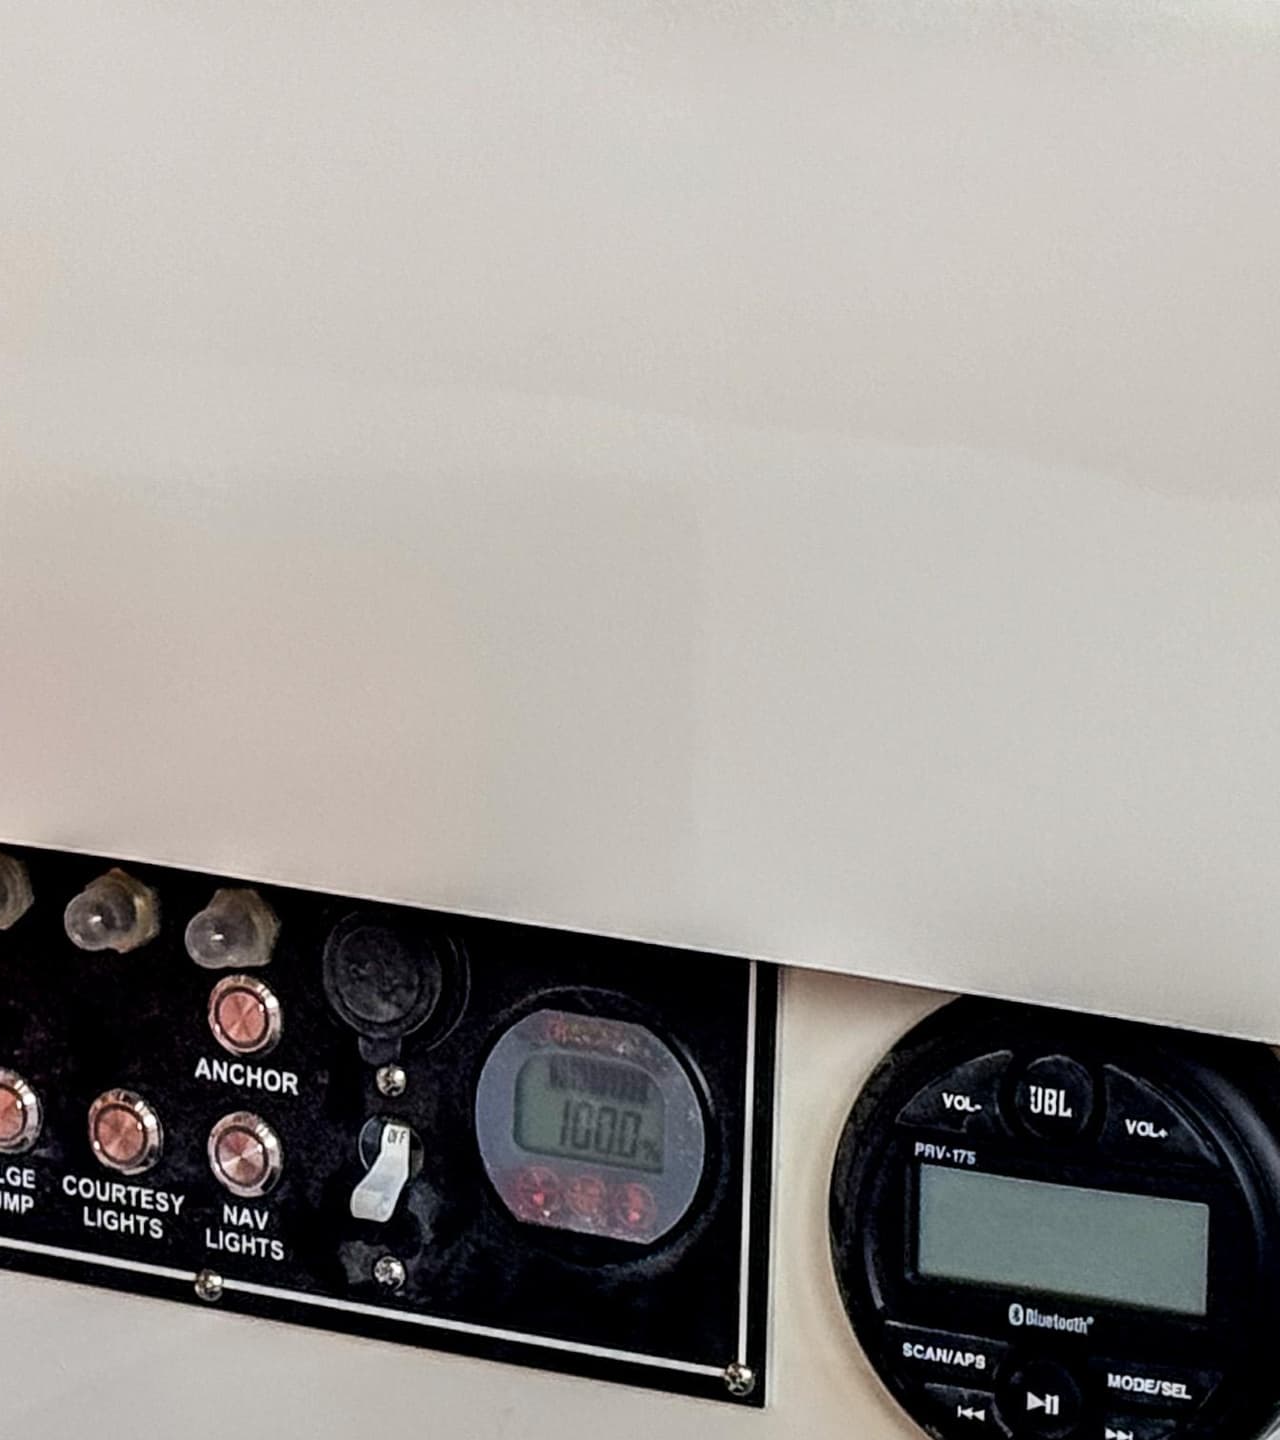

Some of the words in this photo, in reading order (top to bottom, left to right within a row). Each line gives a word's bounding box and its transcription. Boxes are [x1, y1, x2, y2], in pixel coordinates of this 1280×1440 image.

[194, 1057, 298, 1096] ANCHOR
[942, 1092, 982, 1112] VOL-
[1029, 1085, 1072, 1118] JBL
[1125, 1118, 1169, 1139] VOL+
[914, 1141, 977, 1165] PRV-175
[62, 1175, 185, 1216] COURTESY
[83, 1206, 164, 1239] LIGHTS
[223, 1203, 269, 1231] NAV
[205, 1227, 285, 1261] LIGHTS
[902, 1341, 986, 1370] SCAN/APS
[1107, 1372, 1192, 1400] MODE/SEL
